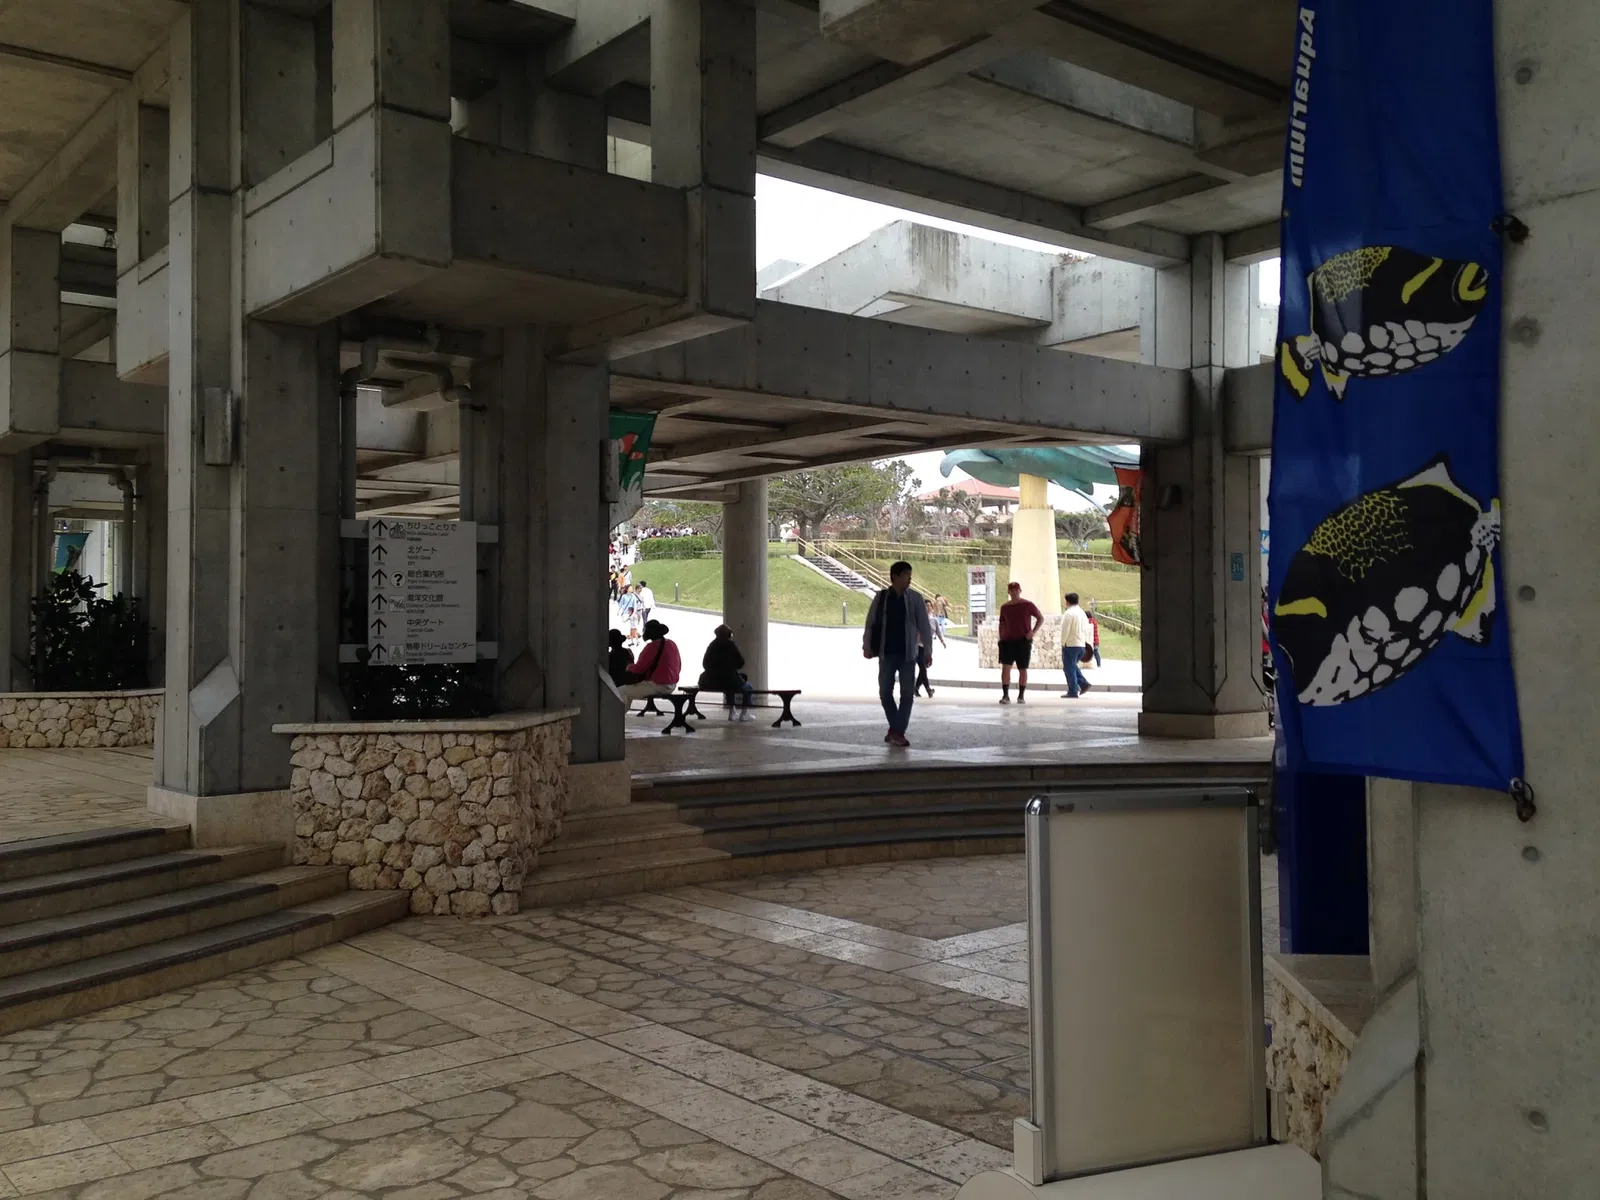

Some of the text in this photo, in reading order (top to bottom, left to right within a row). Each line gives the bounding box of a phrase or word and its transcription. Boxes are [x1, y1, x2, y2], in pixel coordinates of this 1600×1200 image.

[407, 522, 457, 531] ちびっことりで
[407, 546, 438, 554] 北ゲート
[406, 619, 444, 627] 中央ゲート
